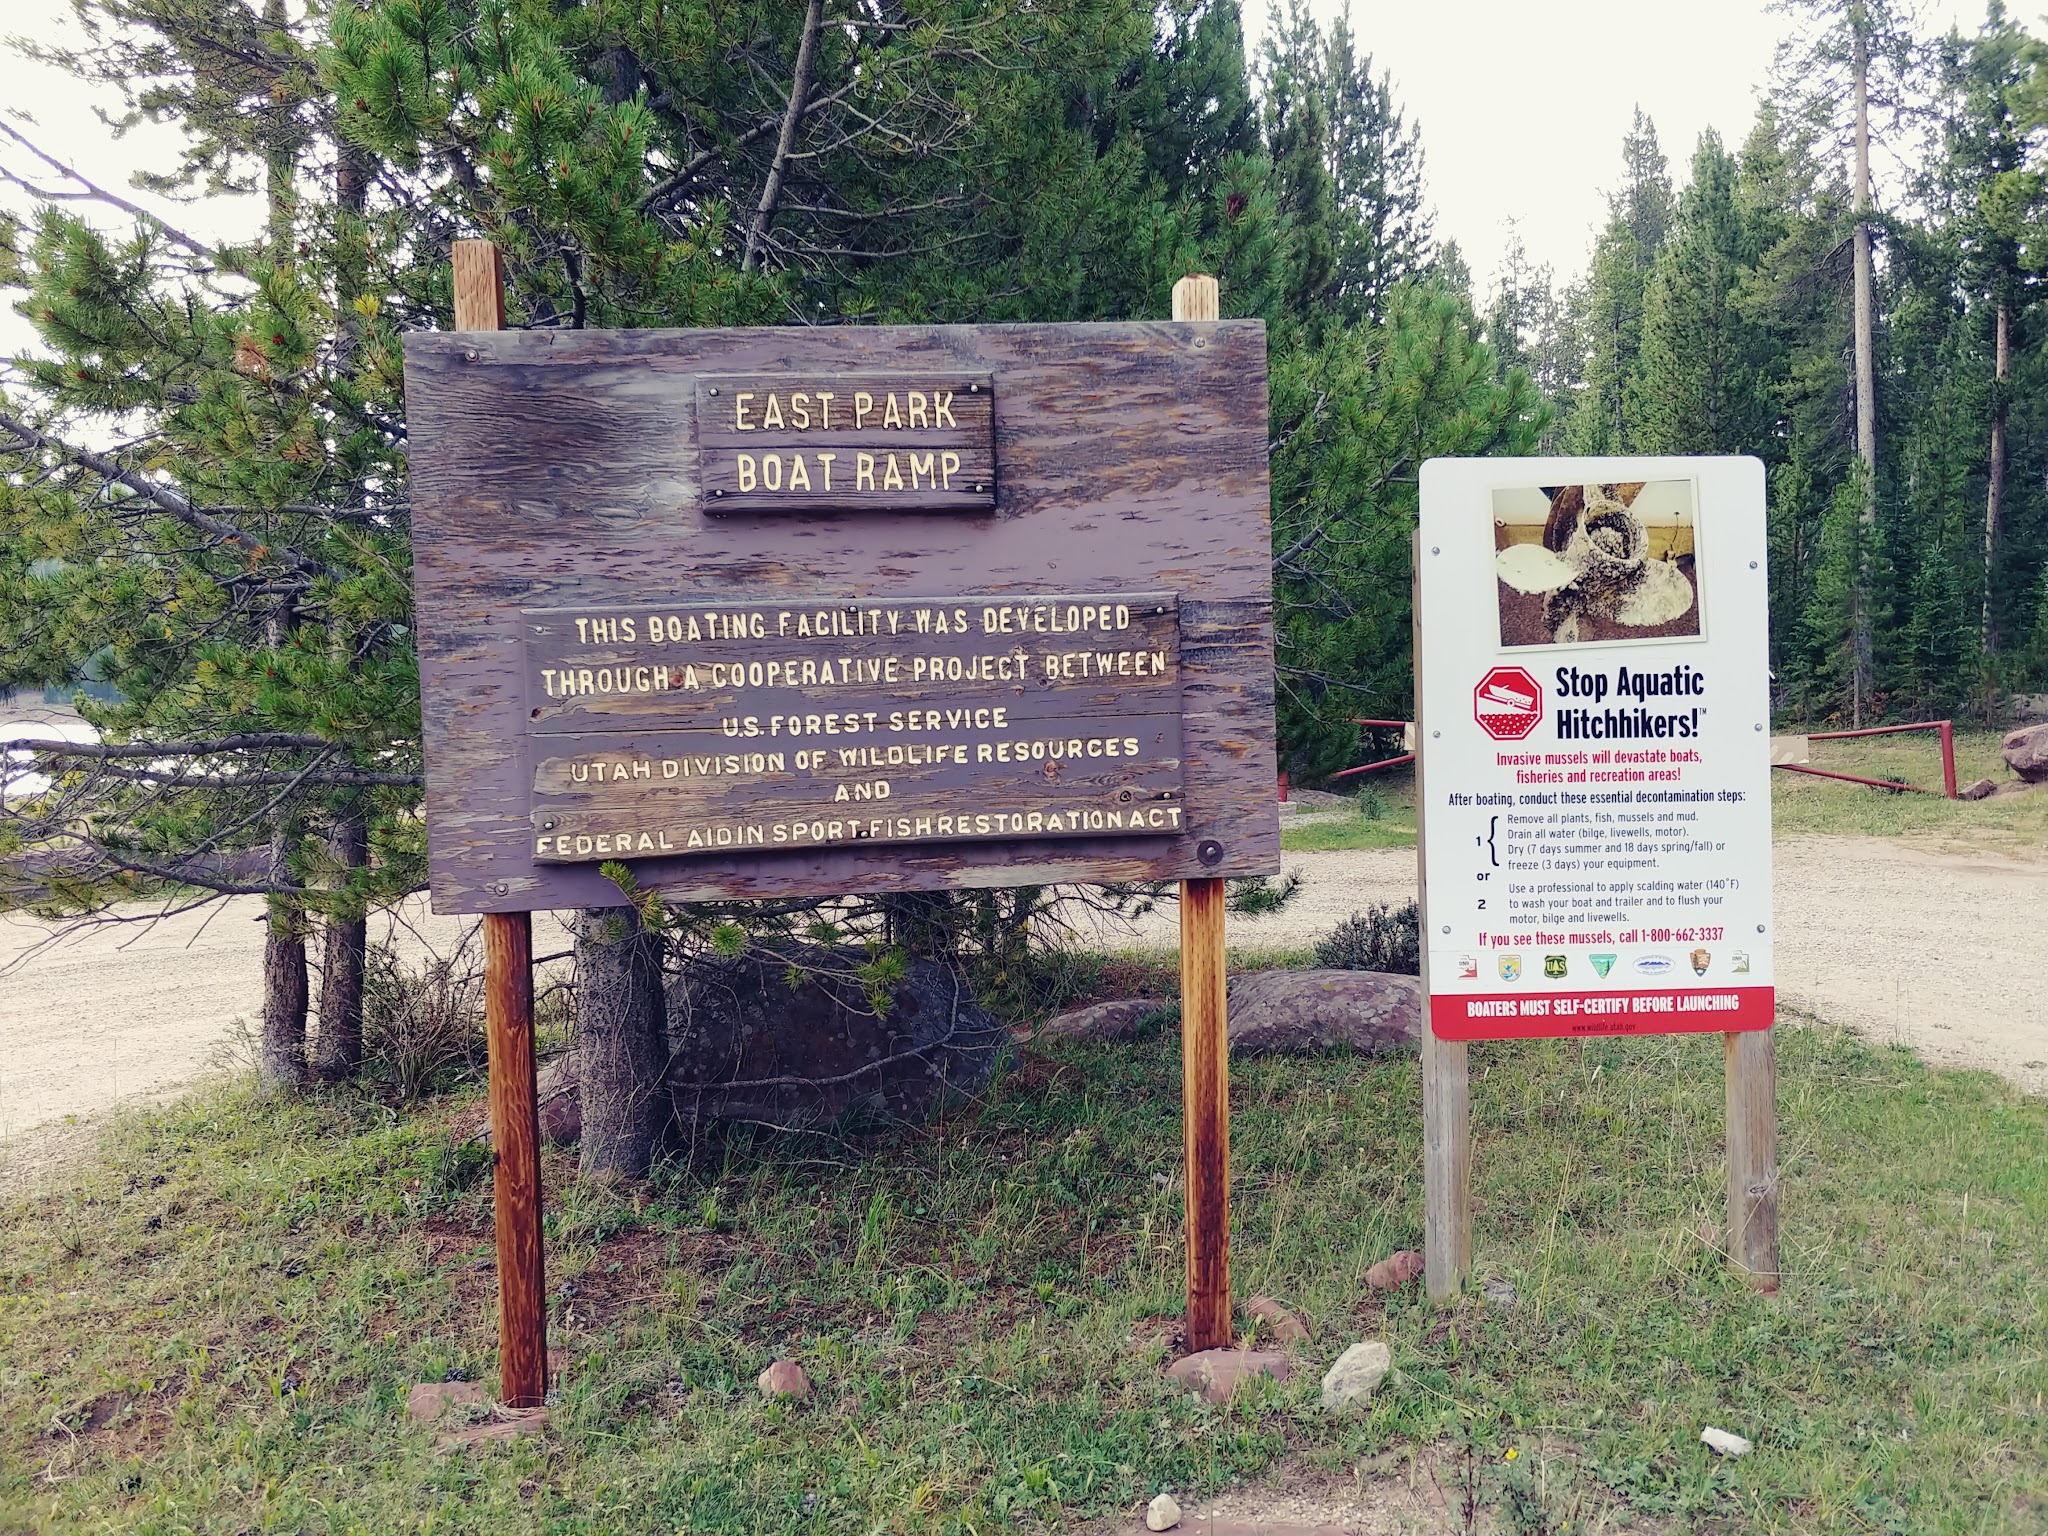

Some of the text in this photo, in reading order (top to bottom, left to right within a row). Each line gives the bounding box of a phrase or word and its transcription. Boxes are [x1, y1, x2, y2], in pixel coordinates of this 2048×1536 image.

[736, 390, 957, 430] EAST PARK
[737, 452, 960, 492] BOAT RAMP
[574, 604, 1130, 644] THIS BOATING FACILITY WAS DEVELOPED
[540, 651, 1166, 696] THROUGH A COOPERATIVE PROJECT BETWEEN
[1556, 665, 1704, 704] Stop Aquatic
[771, 712, 878, 736] FOREST
[889, 708, 1008, 732] SERVICE
[570, 738, 1140, 782] UTAH DIVISION OF WILDLIFE RESOURCES
[1497, 749, 1702, 766] Invasive mussels will devastate boats,
[1517, 768, 1681, 784] fisheries and recreation areas!
[834, 780, 890, 802] AND
[1449, 790, 1746, 807] After boating, conduct these essential decontamination steps:
[1508, 811, 1698, 825] Remove all plants, fish, mussels and mud.
[536, 831, 674, 855] FEDERAL
[1129, 808, 1182, 828] ACT
[1508, 826, 1689, 840] Drain all water (bilge, livewells, motor).
[1476, 836, 1481, 846] 1
[1508, 840, 1726, 856] Dry (7 days summer and 18 days spring/fall) or
[1508, 858, 1660, 871] freeze (3 days) your equipment.
[1476, 872, 1490, 880] or
[1509, 884, 1526, 893] Use
[1538, 882, 1594, 894] professional
[1597, 882, 1606, 892] to
[1609, 881, 1634, 893] apply
[1637, 880, 1674, 892] scalding
[1677, 880, 1703, 890] water
[1478, 899, 1486, 910] 2
[1510, 895, 1724, 910] to wash your boat and trailer and to flush your
[1510, 912, 1630, 925] motor, bilge and livewells.
[1479, 928, 1724, 949] If you see these mussels, call 1-800-662-3337
[1468, 994, 1739, 1018] BOATERS MUST SELF-CERTIFY BEFORE LAUNCHING
